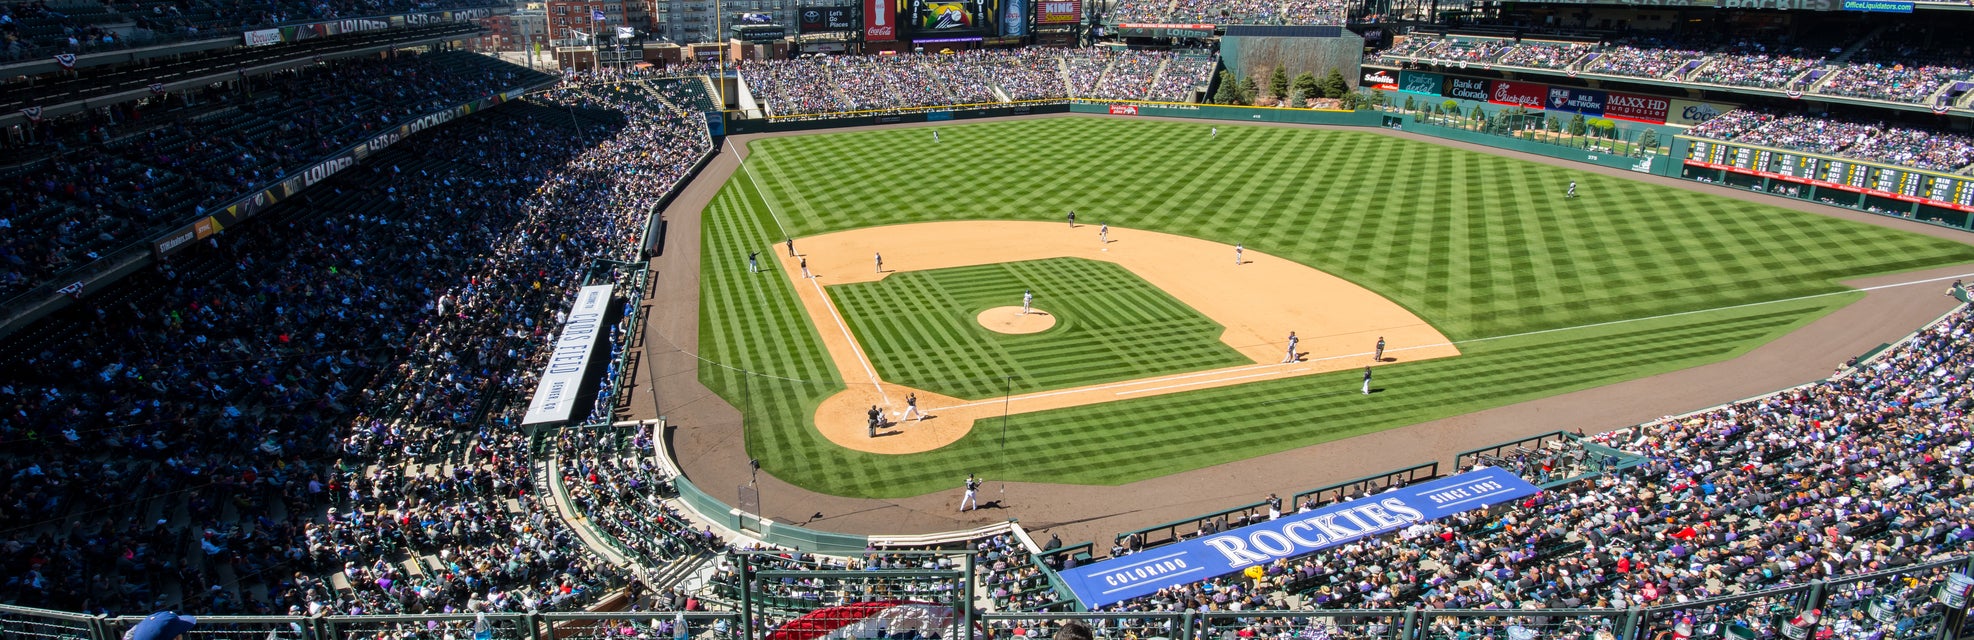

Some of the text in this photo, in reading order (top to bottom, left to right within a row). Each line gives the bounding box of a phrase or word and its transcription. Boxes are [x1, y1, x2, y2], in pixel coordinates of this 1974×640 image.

[1045, 3, 1074, 13] KING
[1844, 1, 1912, 11] OfficeLiquidators.com
[1364, 74, 1395, 84] Safelite
[1453, 79, 1483, 90] Bank of
[1452, 87, 1488, 100] Colorado
[1551, 89, 1569, 98] MLB
[1578, 94, 1593, 102] MLB
[1567, 99, 1601, 109] NETWORK
[1607, 95, 1667, 110] MAXX HD
[1605, 105, 1666, 117] sunglasses
[549, 312, 599, 374] COORS FIELD
[1430, 479, 1502, 505] SINCE 1993
[1203, 496, 1425, 569] ROCKIES
[1105, 557, 1187, 587] COLORADO
